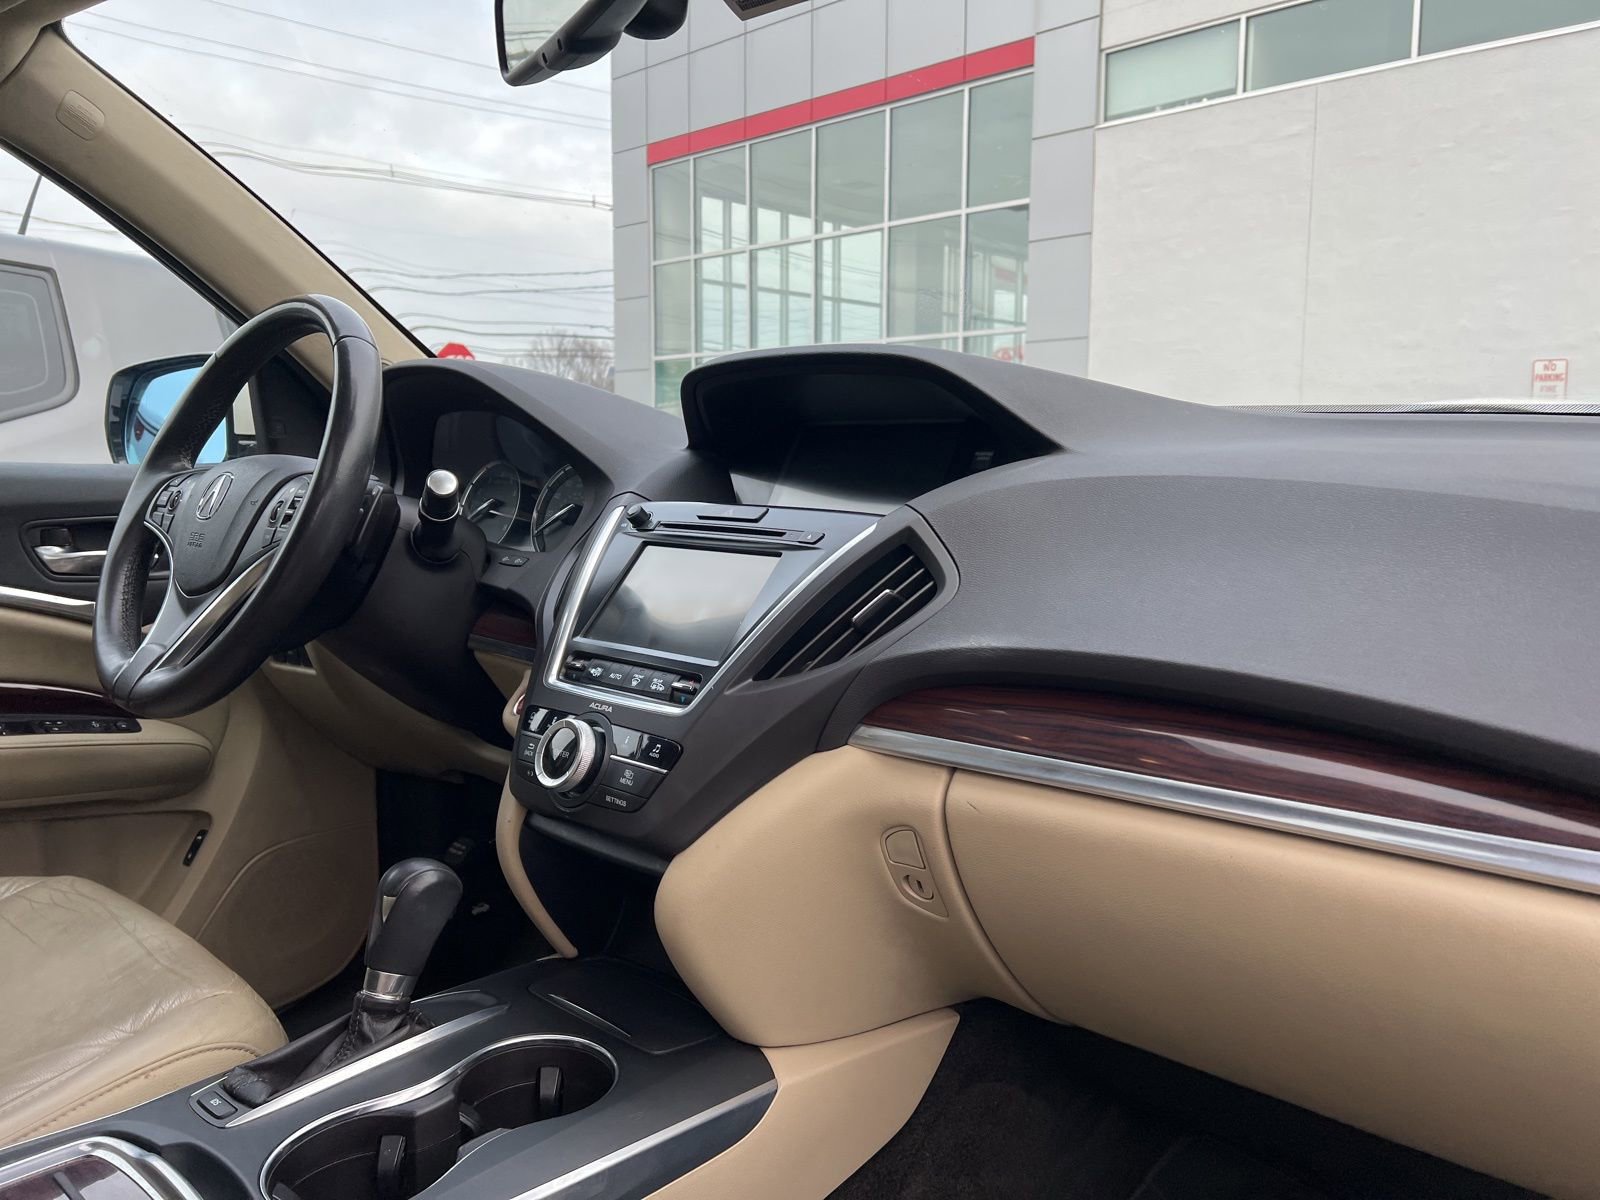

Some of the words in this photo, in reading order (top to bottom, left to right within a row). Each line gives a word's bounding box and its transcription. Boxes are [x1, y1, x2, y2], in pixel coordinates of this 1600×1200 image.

[1543, 363, 1557, 371] NO
[589, 701, 613, 713] ACURA
[620, 777, 634, 786] MENU
[605, 795, 627, 807] SETTINGS
